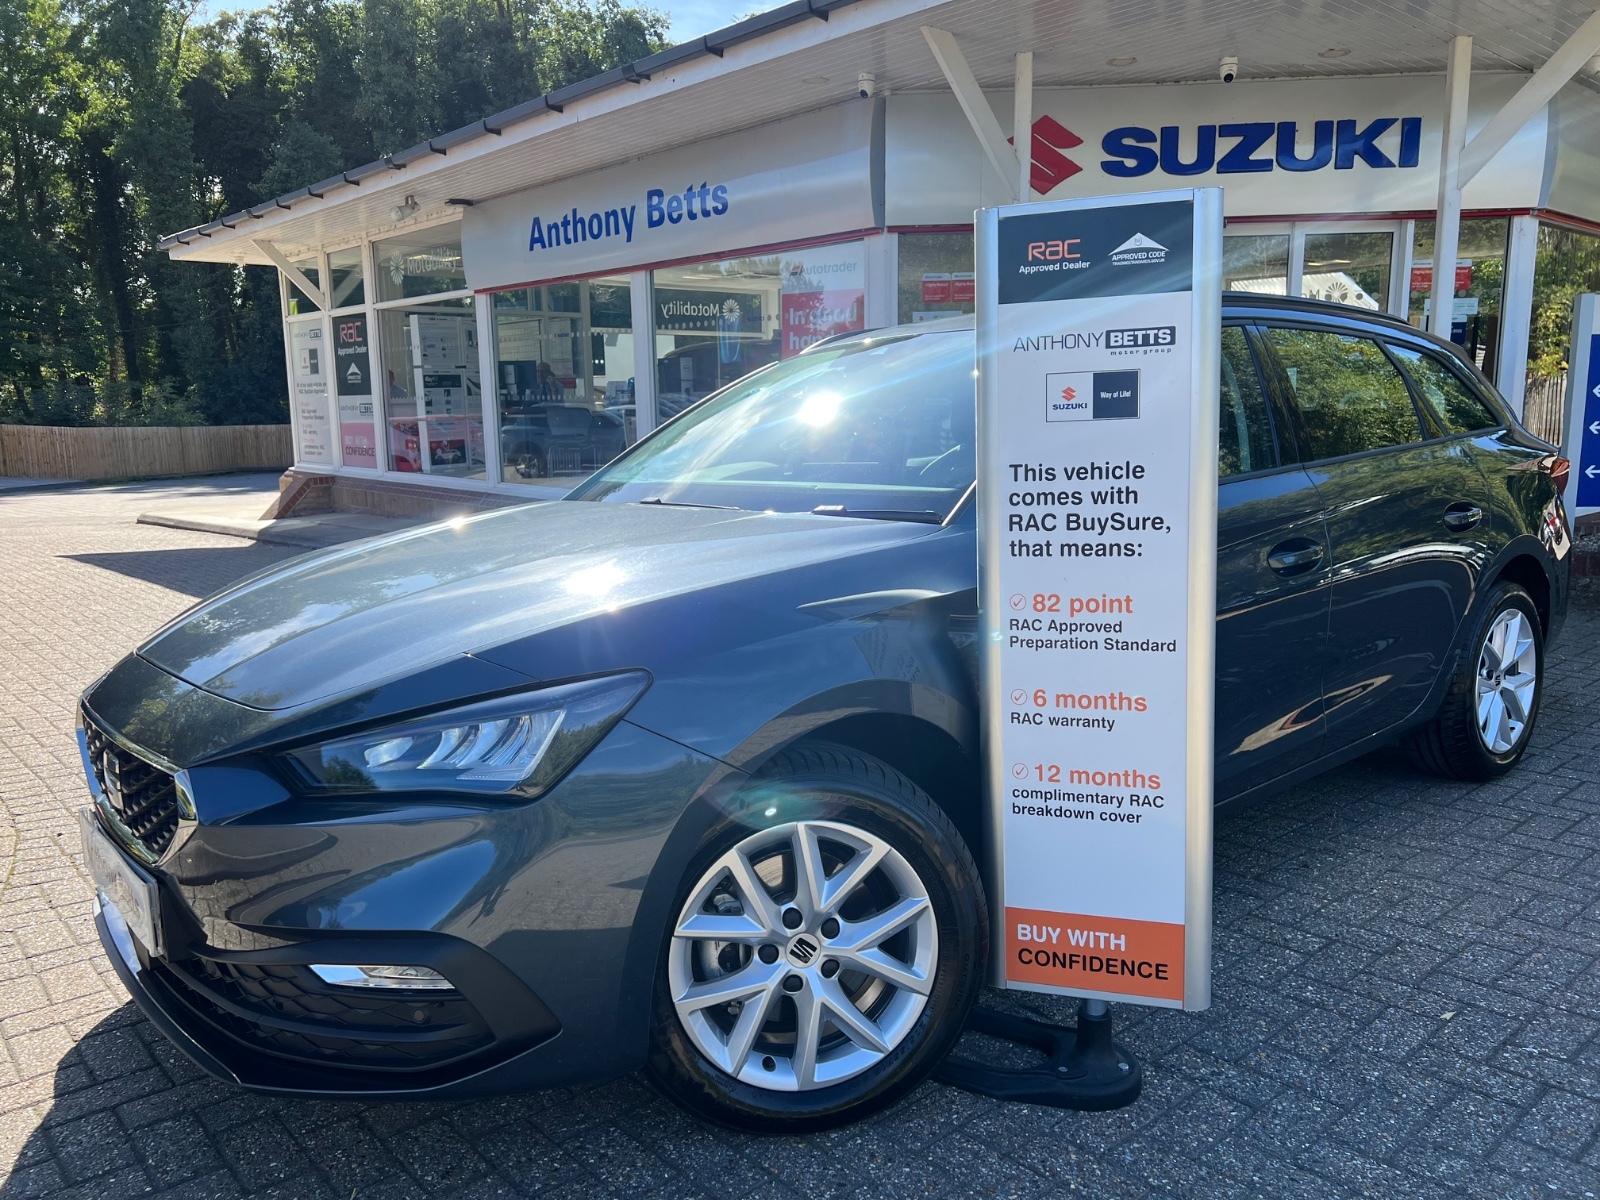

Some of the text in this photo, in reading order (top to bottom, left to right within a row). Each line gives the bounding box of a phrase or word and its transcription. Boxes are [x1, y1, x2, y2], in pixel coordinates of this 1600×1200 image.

[1100, 117, 1422, 178] SUZUKI
[529, 181, 729, 251] Anthony Betts
[1112, 250, 1166, 261] APPROVED CODE
[798, 261, 858, 276] Autotrader
[1019, 260, 1091, 274] Approved Dealer
[789, 308, 806, 325] In
[1013, 329, 1171, 352] ANTHONY BETTS
[1143, 348, 1172, 356] group
[1100, 391, 1112, 399] Way
[1119, 390, 1131, 398] Life!
[346, 446, 375, 457] CONFIDENCE
[1009, 461, 1145, 482] This vehicle
[1008, 486, 1138, 506] comes with
[1008, 512, 1171, 536] RAC BuySure,
[1010, 540, 1143, 557] that means:
[1032, 593, 1133, 618] 82 point
[1010, 618, 1122, 635] RAC Approved
[1010, 635, 1177, 652] Preparation Standard
[1033, 689, 1148, 712] 6 months
[1010, 712, 1116, 732] RAC warranty
[1034, 763, 1161, 790] 12 months
[1012, 788, 1165, 809] complimentary RAC
[1012, 802, 1142, 824] breakdown cover
[1017, 923, 1126, 952] BUY WITH
[1018, 947, 1169, 981] CONFIDENCE
